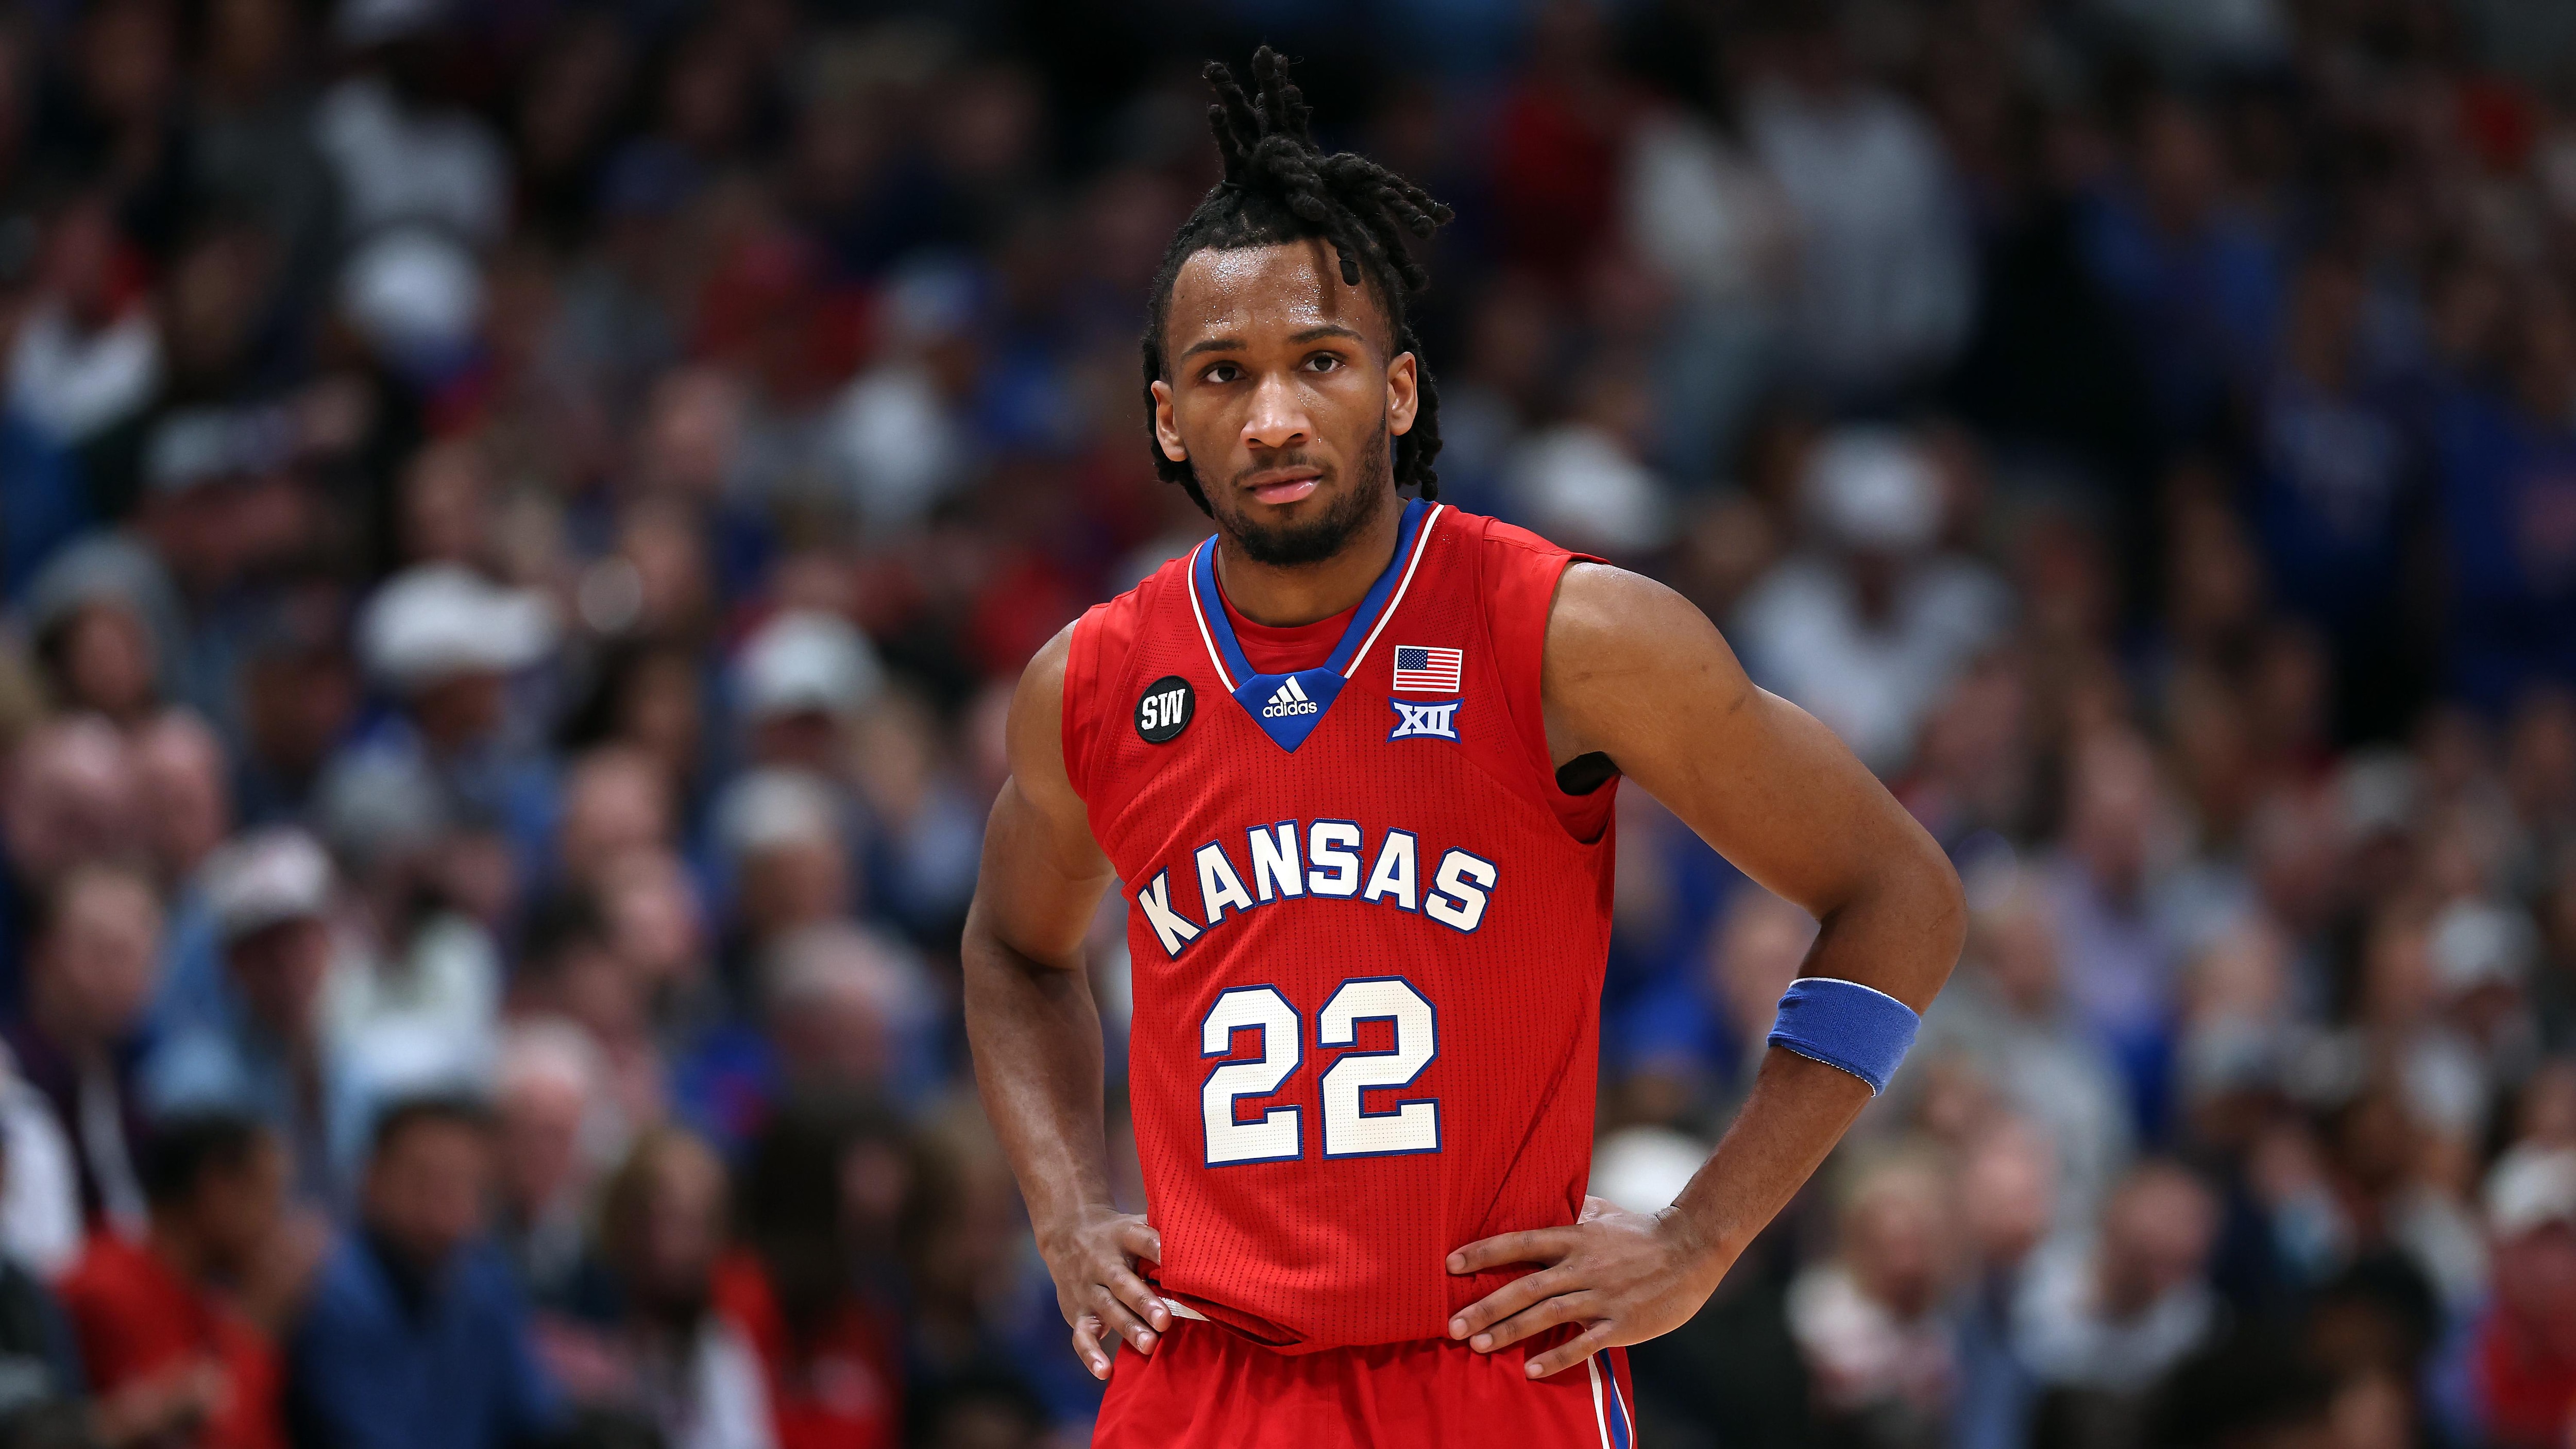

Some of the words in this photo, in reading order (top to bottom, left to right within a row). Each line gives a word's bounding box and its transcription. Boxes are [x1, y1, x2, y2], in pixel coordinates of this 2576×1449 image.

[1140, 688, 1186, 730] SW
[1262, 700, 1318, 718] adidas
[1389, 700, 1461, 740] XII
[1137, 817, 1500, 960] KANSAS
[1200, 975, 1443, 1169] 22
